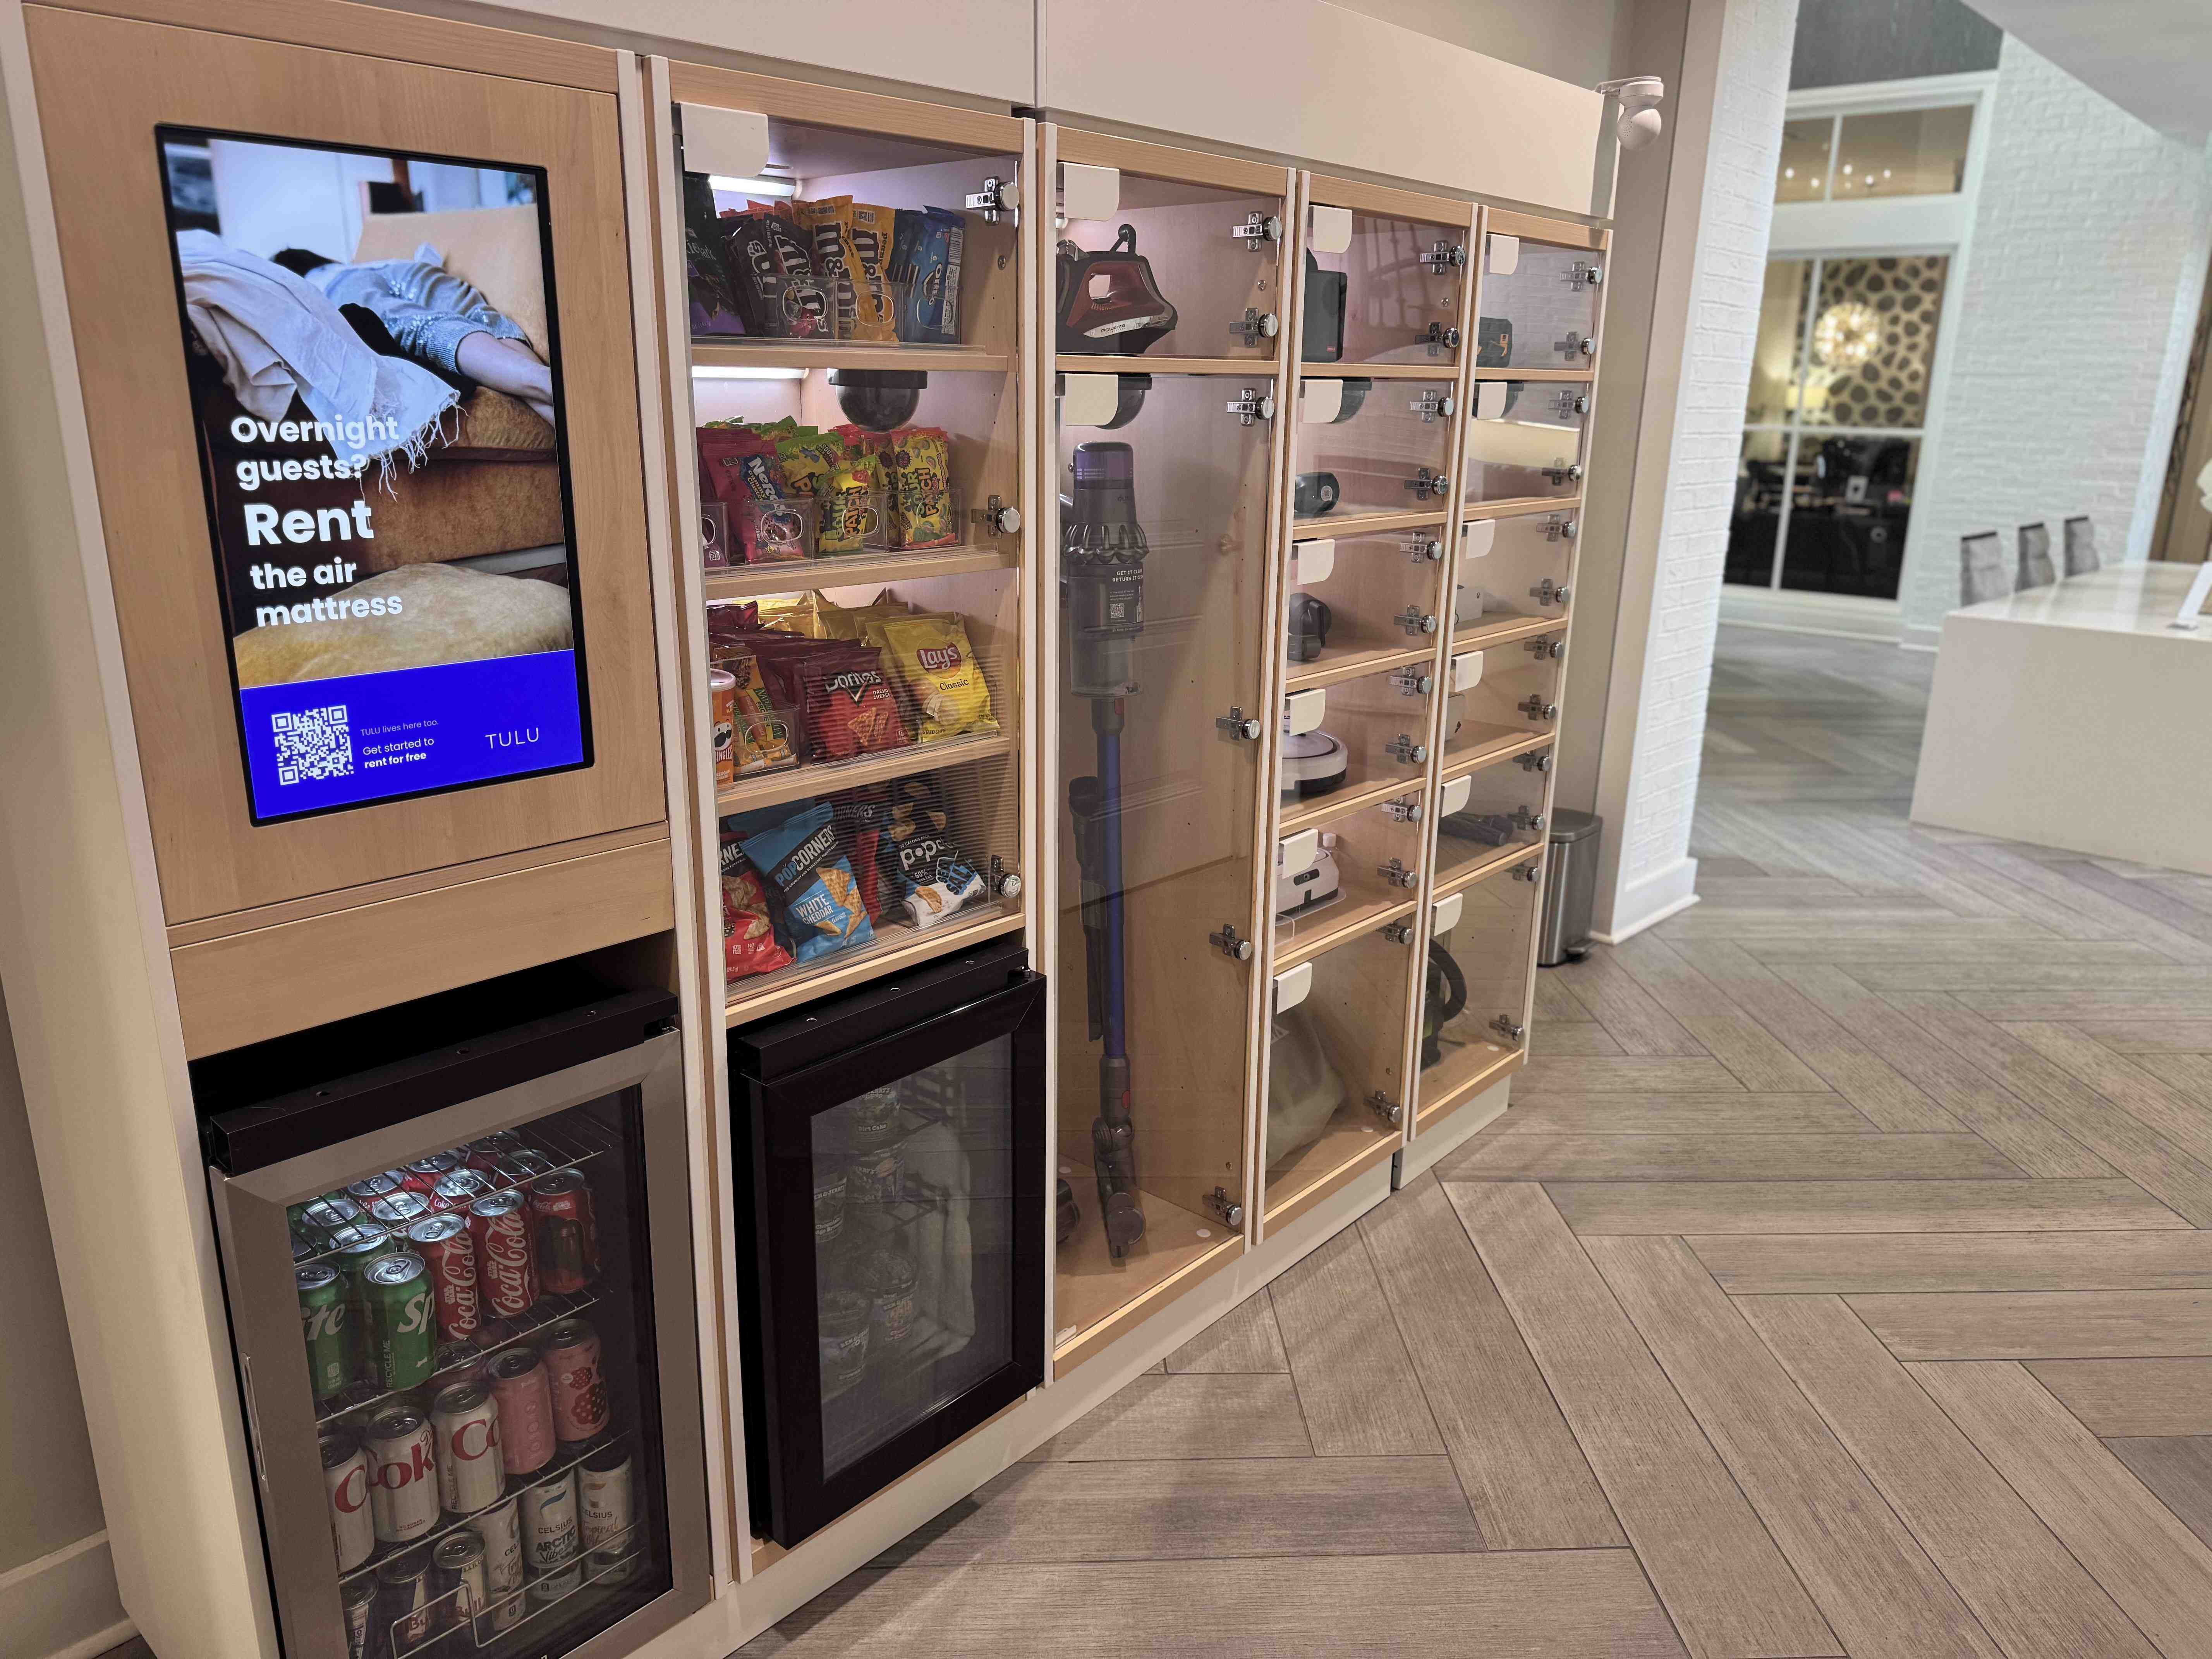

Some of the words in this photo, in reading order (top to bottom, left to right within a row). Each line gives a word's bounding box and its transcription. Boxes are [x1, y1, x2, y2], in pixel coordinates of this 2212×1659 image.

[231, 414, 399, 449] Overnight
[236, 454, 367, 491] guests?
[244, 500, 374, 546] Rent
[250, 563, 307, 589] the
[313, 556, 357, 584] air
[256, 596, 403, 627] mattress
[920, 647, 957, 670] Lay's
[939, 679, 969, 690] Classic
[360, 727, 380, 736] TULU
[485, 727, 540, 749] TULU
[363, 745, 382, 755] Get
[384, 738, 421, 752] started
[424, 738, 434, 746] to
[716, 745, 732, 763] INGLES
[364, 757, 387, 769] rent
[389, 756, 404, 764] for
[406, 753, 426, 762] free
[796, 893, 830, 917] WHITE
[802, 905, 834, 925] CHEDDAR
[452, 1417, 500, 1461] Co
[538, 1516, 572, 1534] CELSIUS
